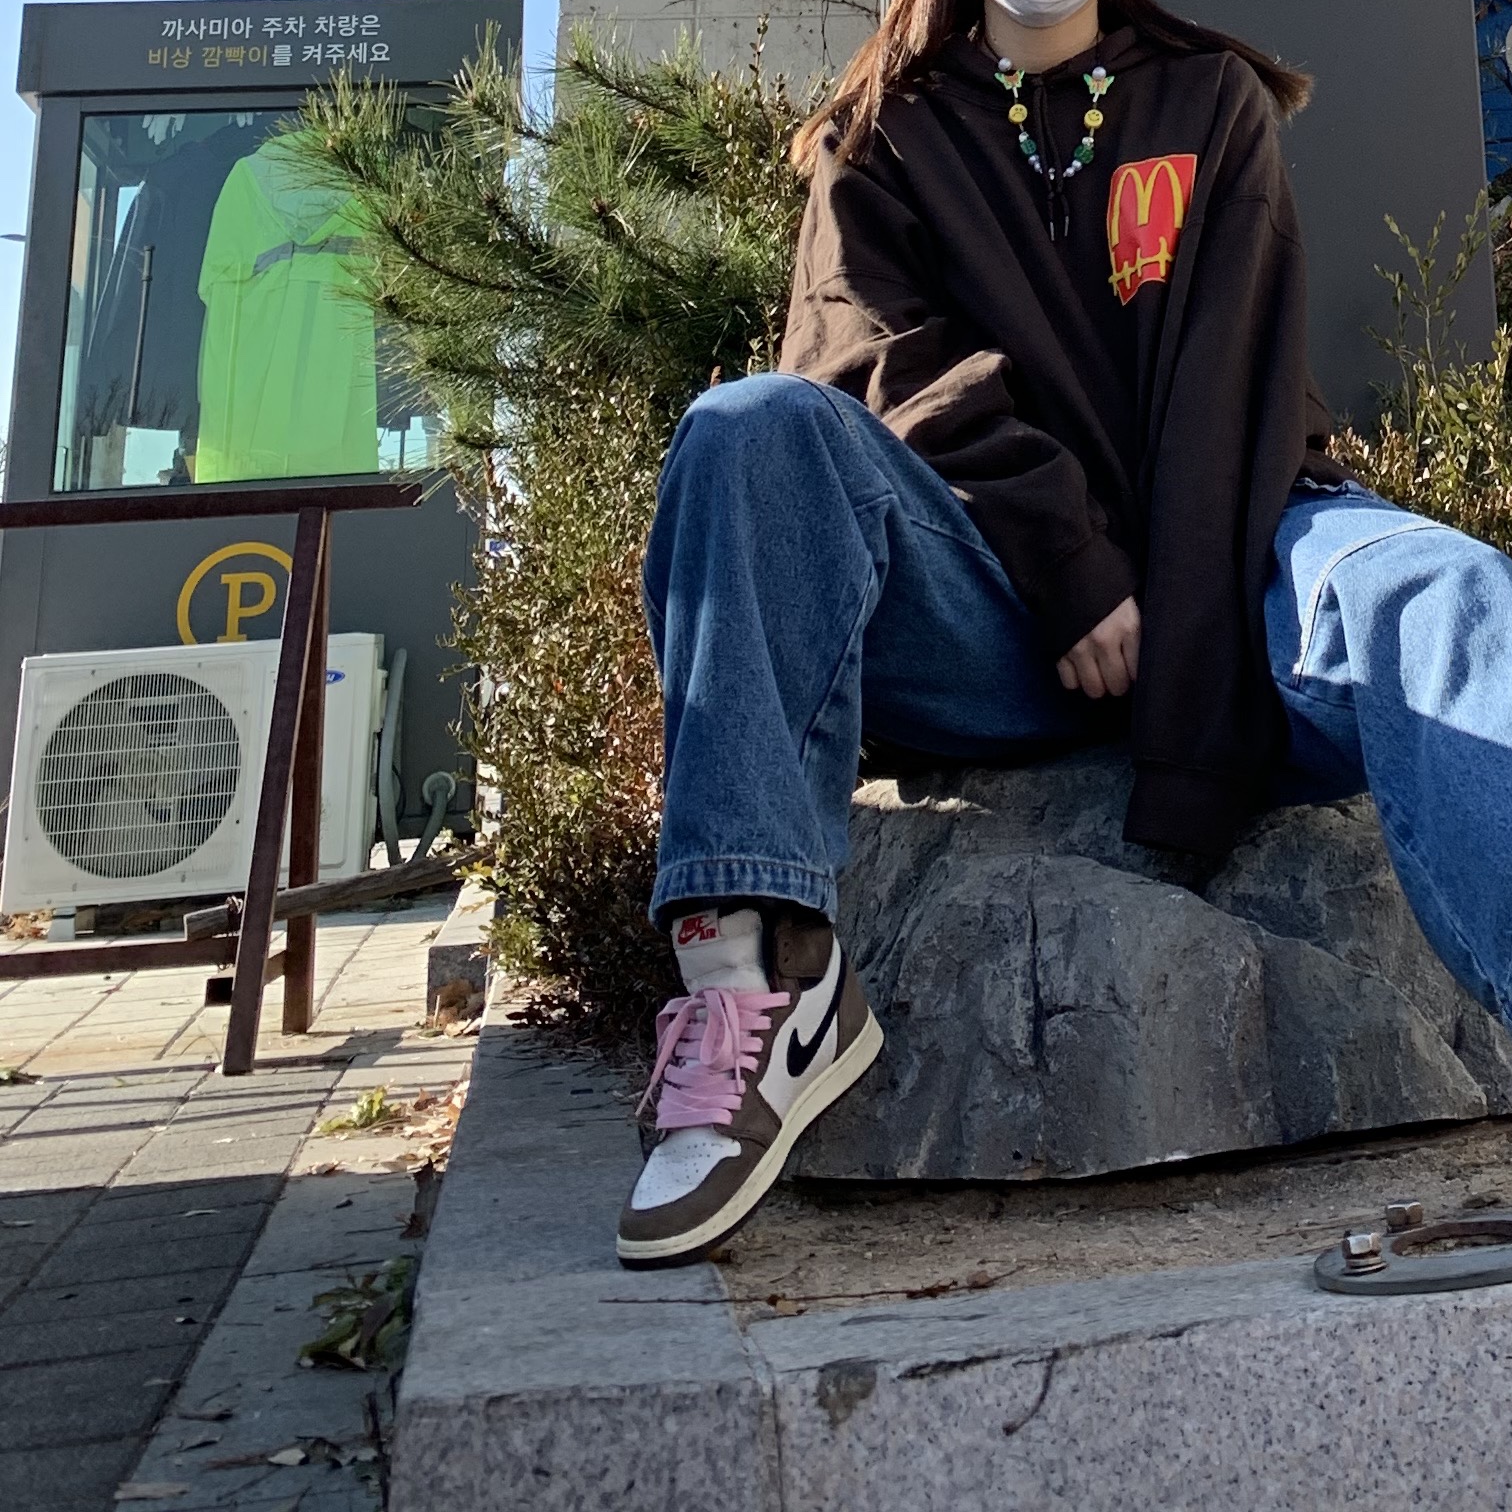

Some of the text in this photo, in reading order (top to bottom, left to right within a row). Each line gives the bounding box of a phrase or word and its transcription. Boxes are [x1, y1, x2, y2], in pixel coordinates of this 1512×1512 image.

[161, 14, 381, 40] 까사미아 주차 차량은
[148, 42, 390, 69] 비상 깜빡이를 켜주세요
[216, 571, 277, 643] P
